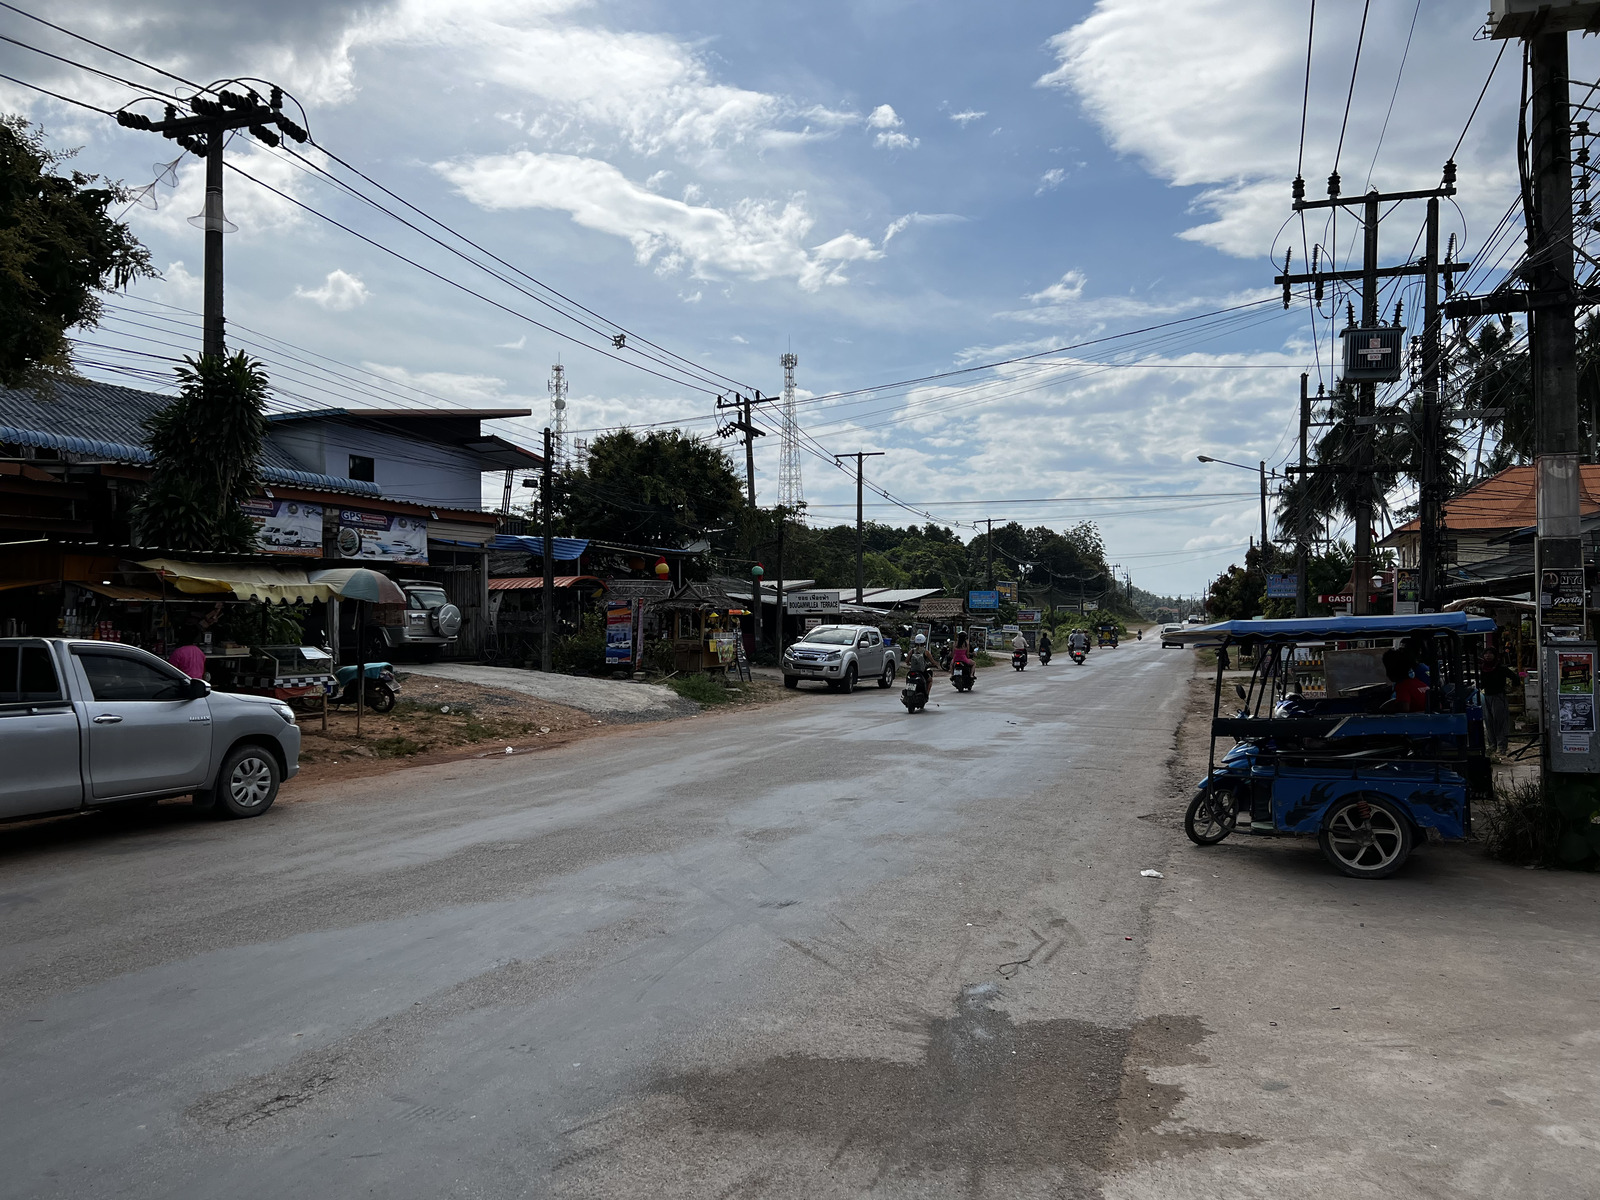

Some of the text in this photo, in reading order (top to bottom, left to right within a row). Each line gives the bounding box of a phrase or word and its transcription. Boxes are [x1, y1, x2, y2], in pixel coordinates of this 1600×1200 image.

[342, 511, 362, 521] GPS
[1560, 576, 1582, 585] NYE
[1554, 597, 1583, 606] Party
